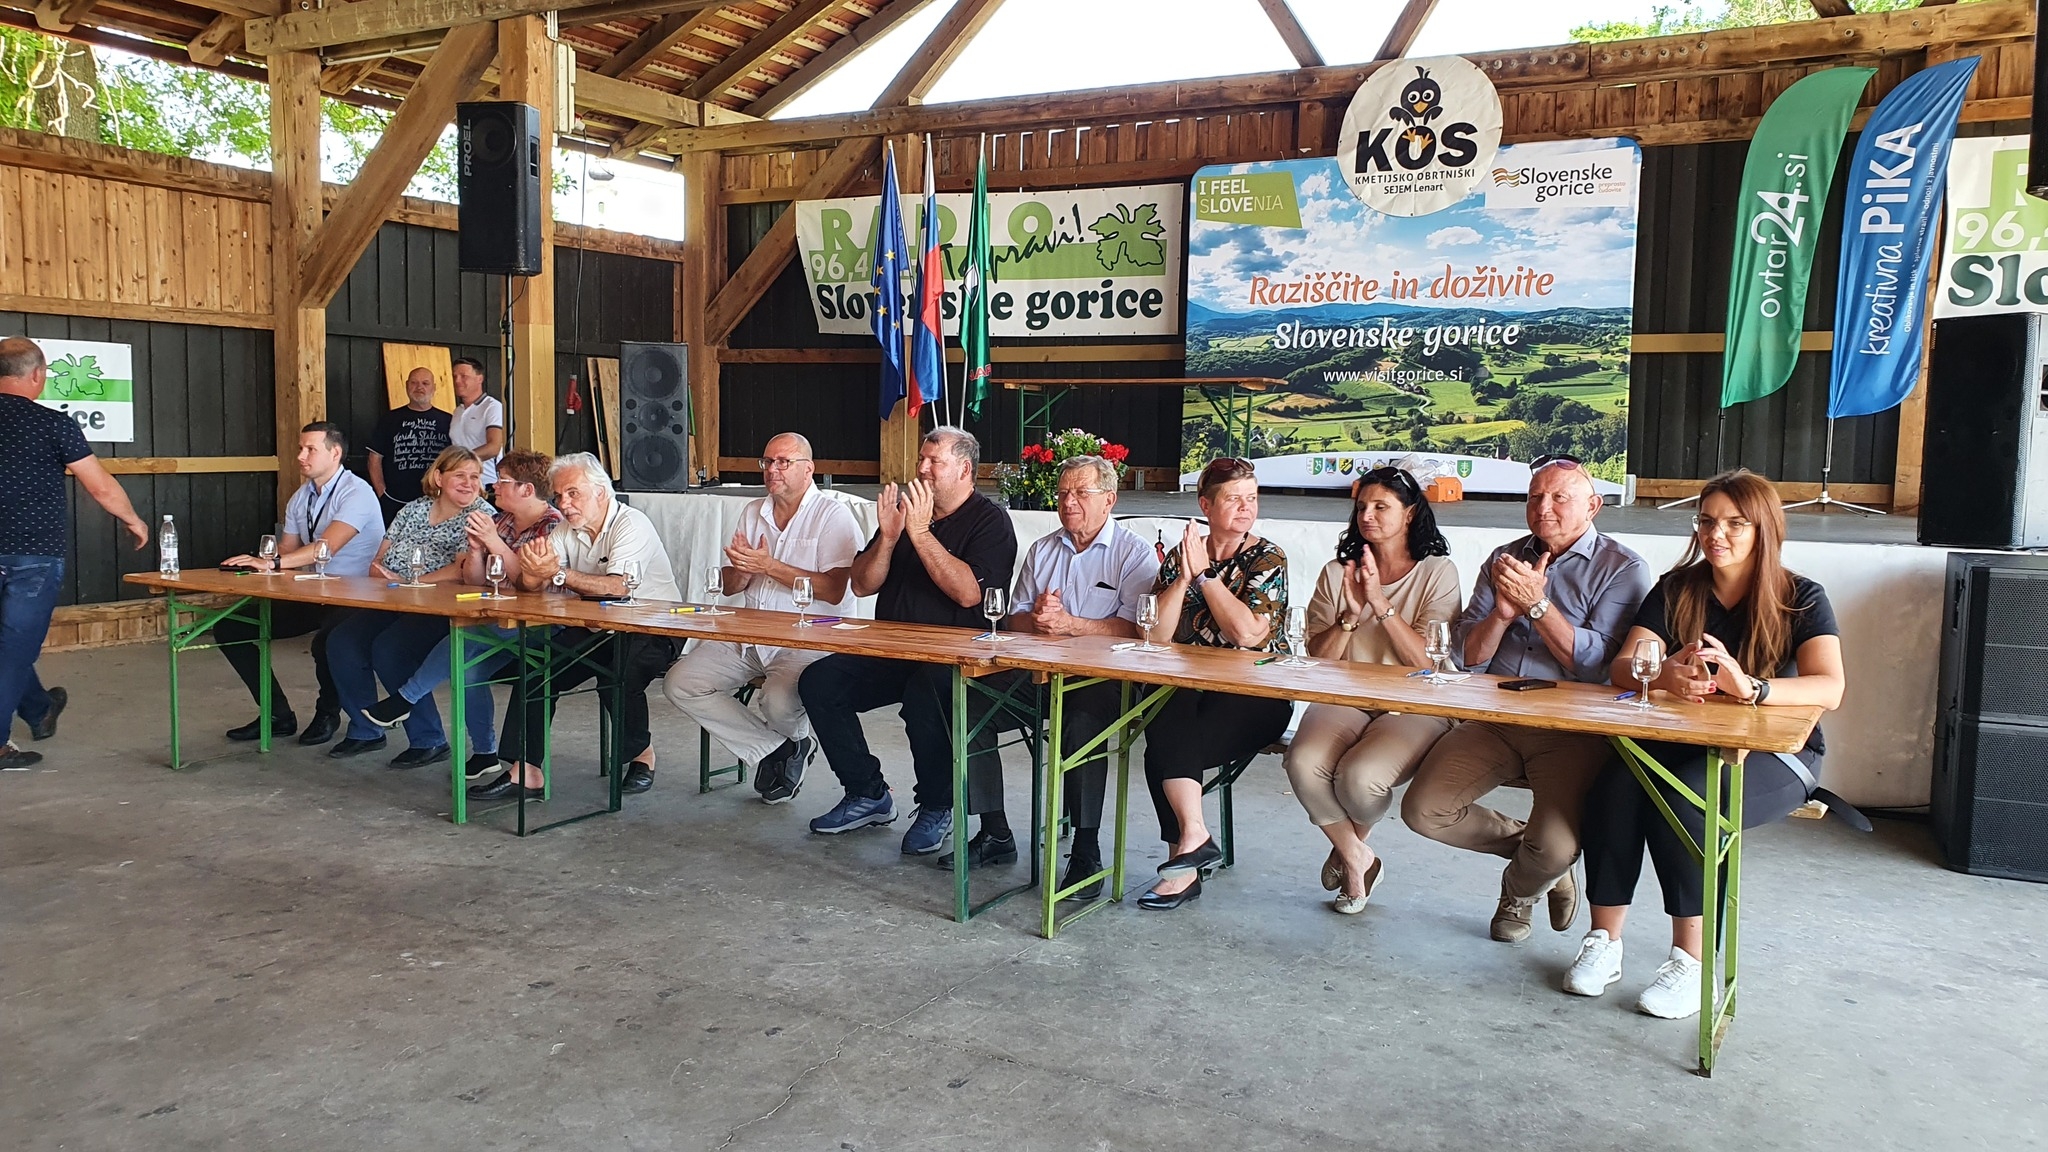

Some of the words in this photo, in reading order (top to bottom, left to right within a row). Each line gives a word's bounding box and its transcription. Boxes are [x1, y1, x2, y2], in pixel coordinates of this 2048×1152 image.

[463, 119, 473, 177] PROEL
[1355, 122, 1478, 174] KOS
[1199, 180, 1207, 196] I
[1210, 178, 1251, 196] FEEL
[1355, 172, 1414, 185] KMETIJSKO
[1416, 168, 1475, 181] OBRTNIŠKI
[1519, 162, 1613, 186] Slovenske
[1383, 185, 1413, 195] SEJEM
[1413, 183, 1444, 194] Lenart
[1535, 181, 1595, 203] gorice
[1200, 194, 1285, 215] SLOVENIA
[811, 252, 869, 283] 96,4
[1250, 271, 1379, 306] Raziščite
[1391, 270, 1418, 300] in
[1430, 263, 1555, 300] doživite
[1026, 279, 1163, 331] gorice
[1859, 241, 1903, 356] kreativna
[1274, 317, 1414, 351] Slovenske
[1423, 317, 1520, 356] gorice
[1323, 365, 1463, 387] www.visitgorice.si
